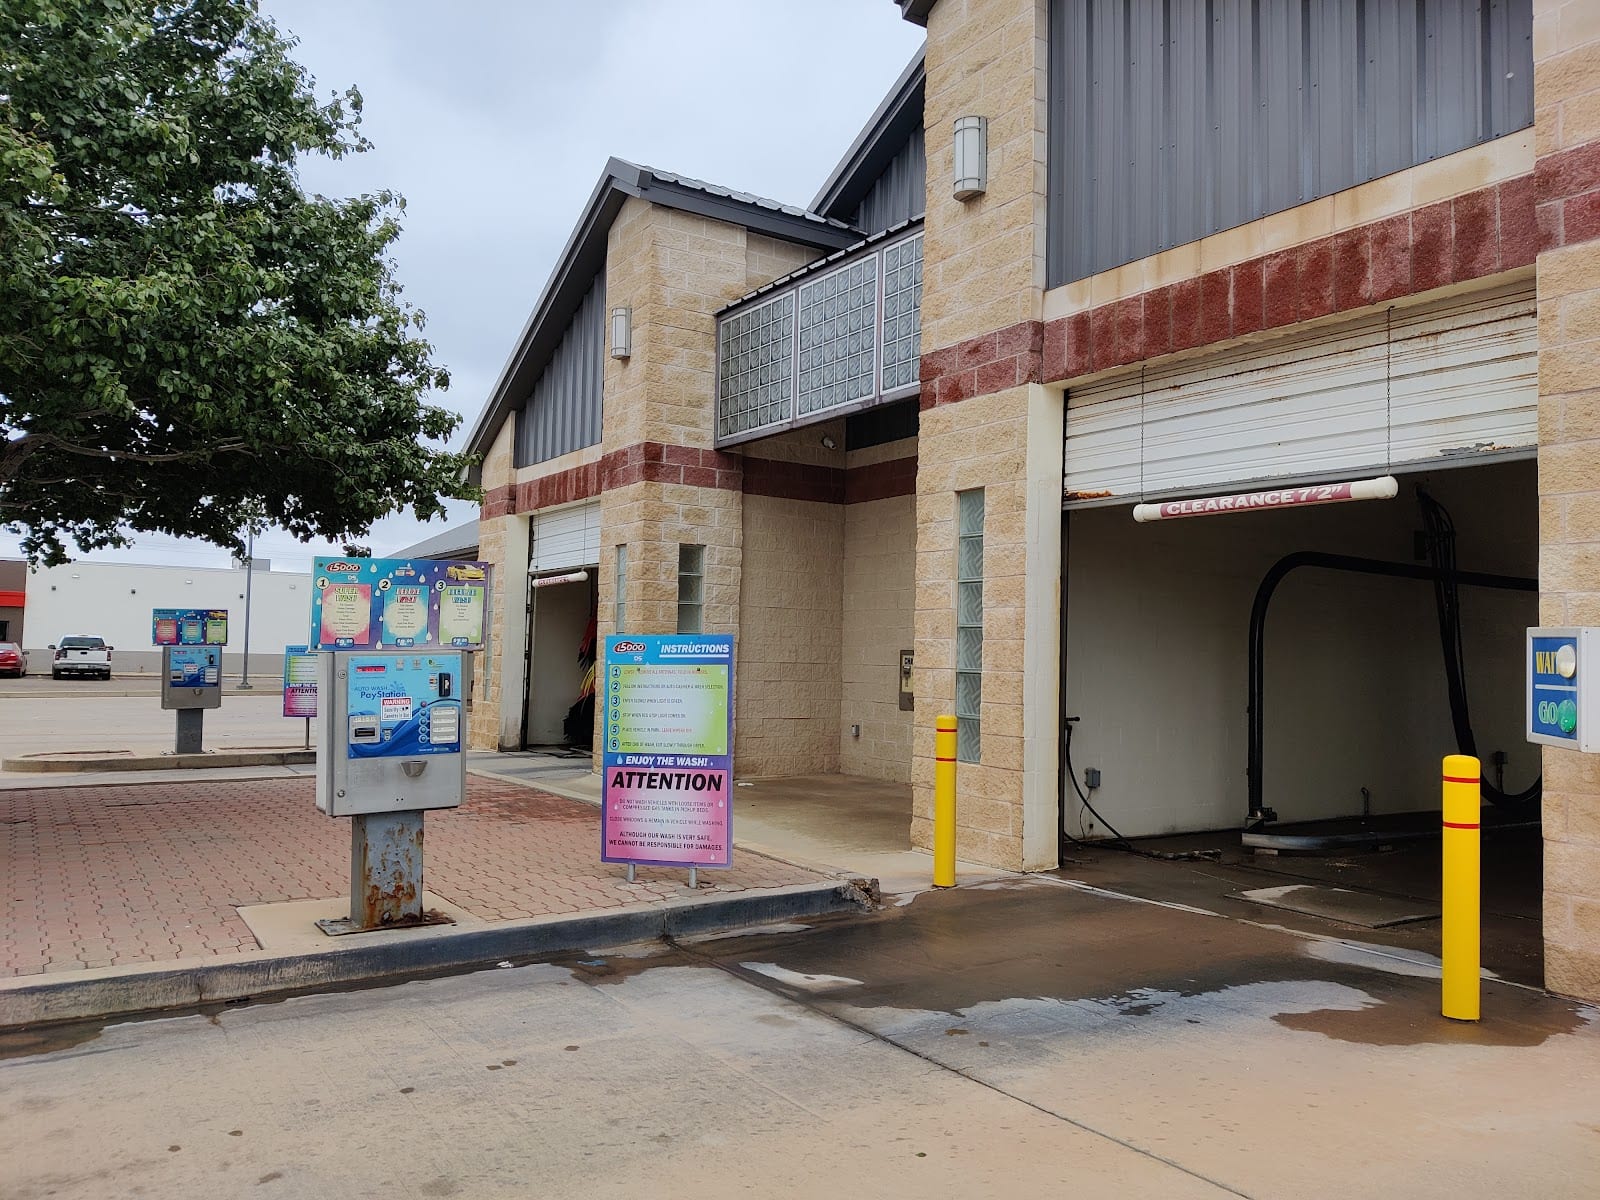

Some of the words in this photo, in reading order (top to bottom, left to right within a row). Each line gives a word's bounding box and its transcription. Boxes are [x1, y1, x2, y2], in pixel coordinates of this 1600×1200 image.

[1166, 492, 1295, 515] CLEARANCE
[330, 563, 359, 571] i5000
[618, 643, 644, 652] i5000
[661, 644, 729, 654] INSTRUCTIONS
[360, 691, 406, 700] PayStation
[1538, 701, 1558, 724] GO
[626, 756, 655, 765] ENJOY
[657, 757, 674, 765] THE
[676, 757, 708, 766] WASH!
[612, 772, 722, 791] ATTENTION
